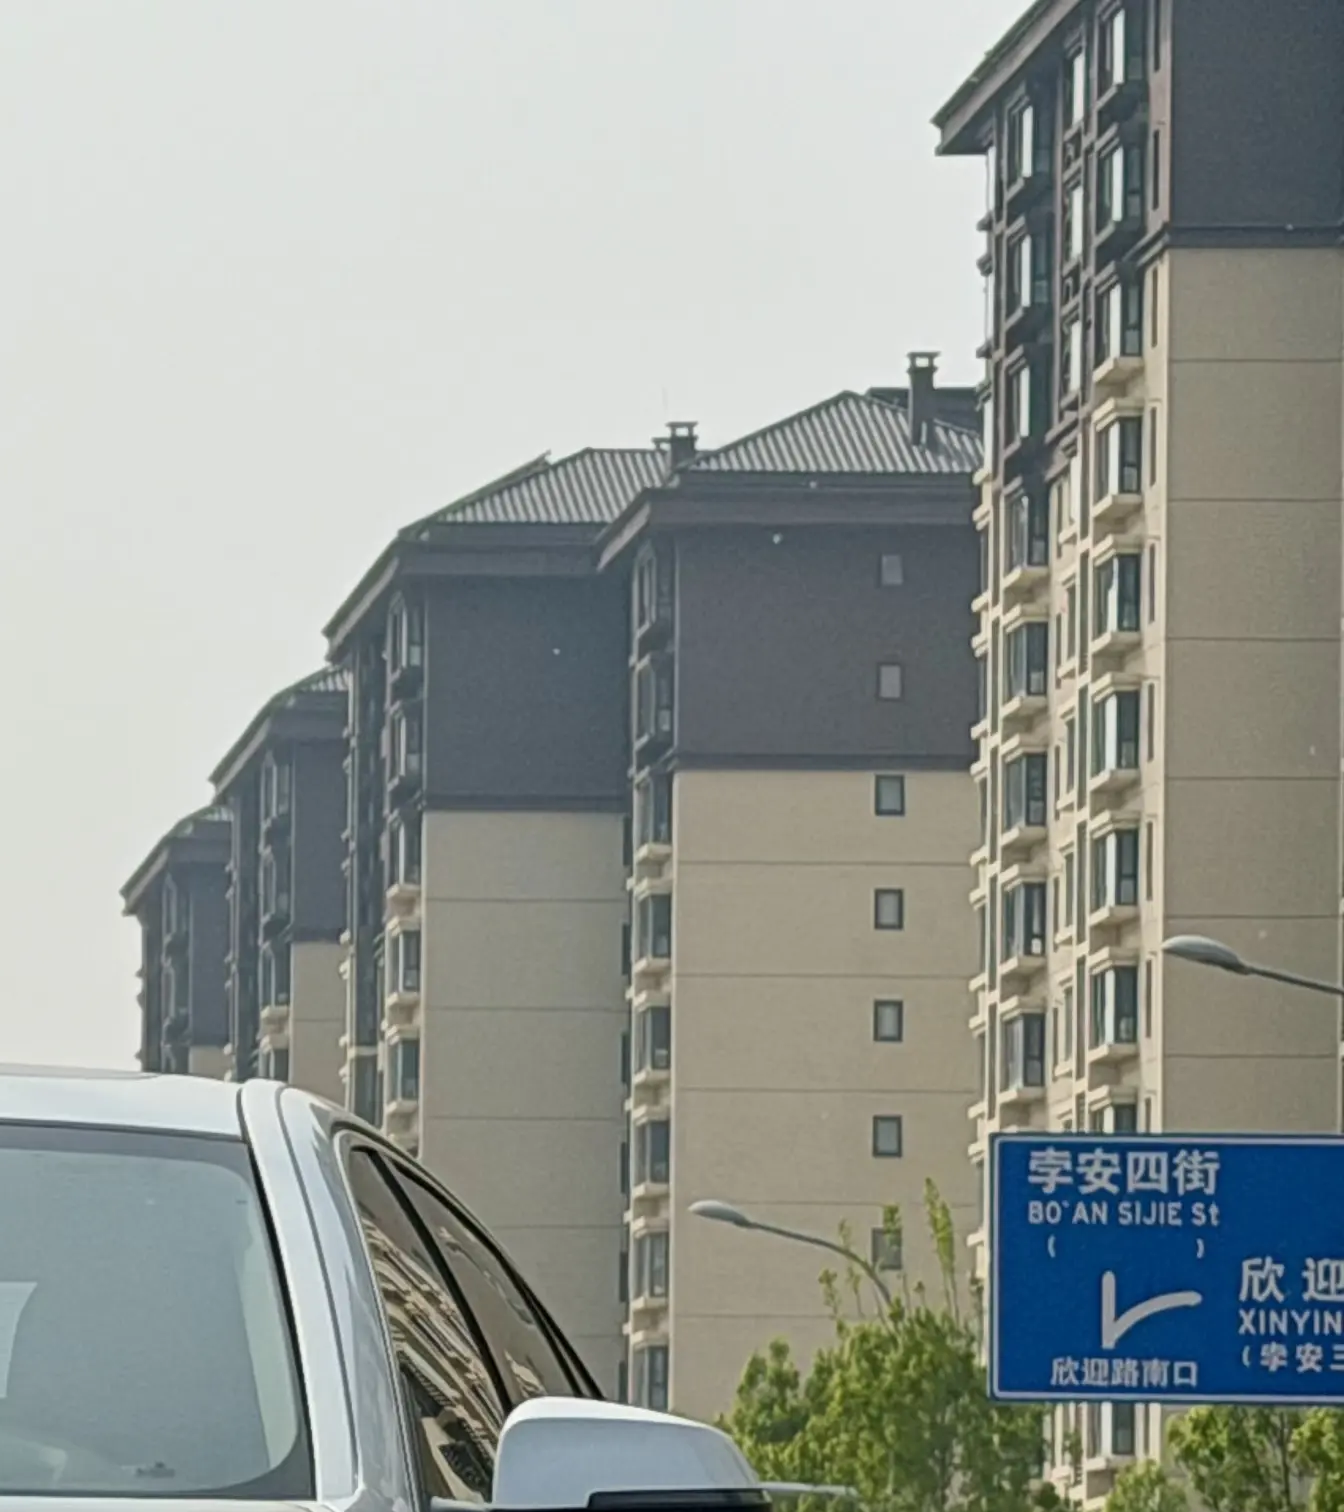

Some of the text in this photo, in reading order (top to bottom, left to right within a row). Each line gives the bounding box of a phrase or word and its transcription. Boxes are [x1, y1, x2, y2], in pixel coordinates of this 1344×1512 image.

[1118, 1201, 1183, 1226] SIJIE
[1191, 1202, 1220, 1226] St
[1050, 1356, 1198, 1387] 欣迎路南口
